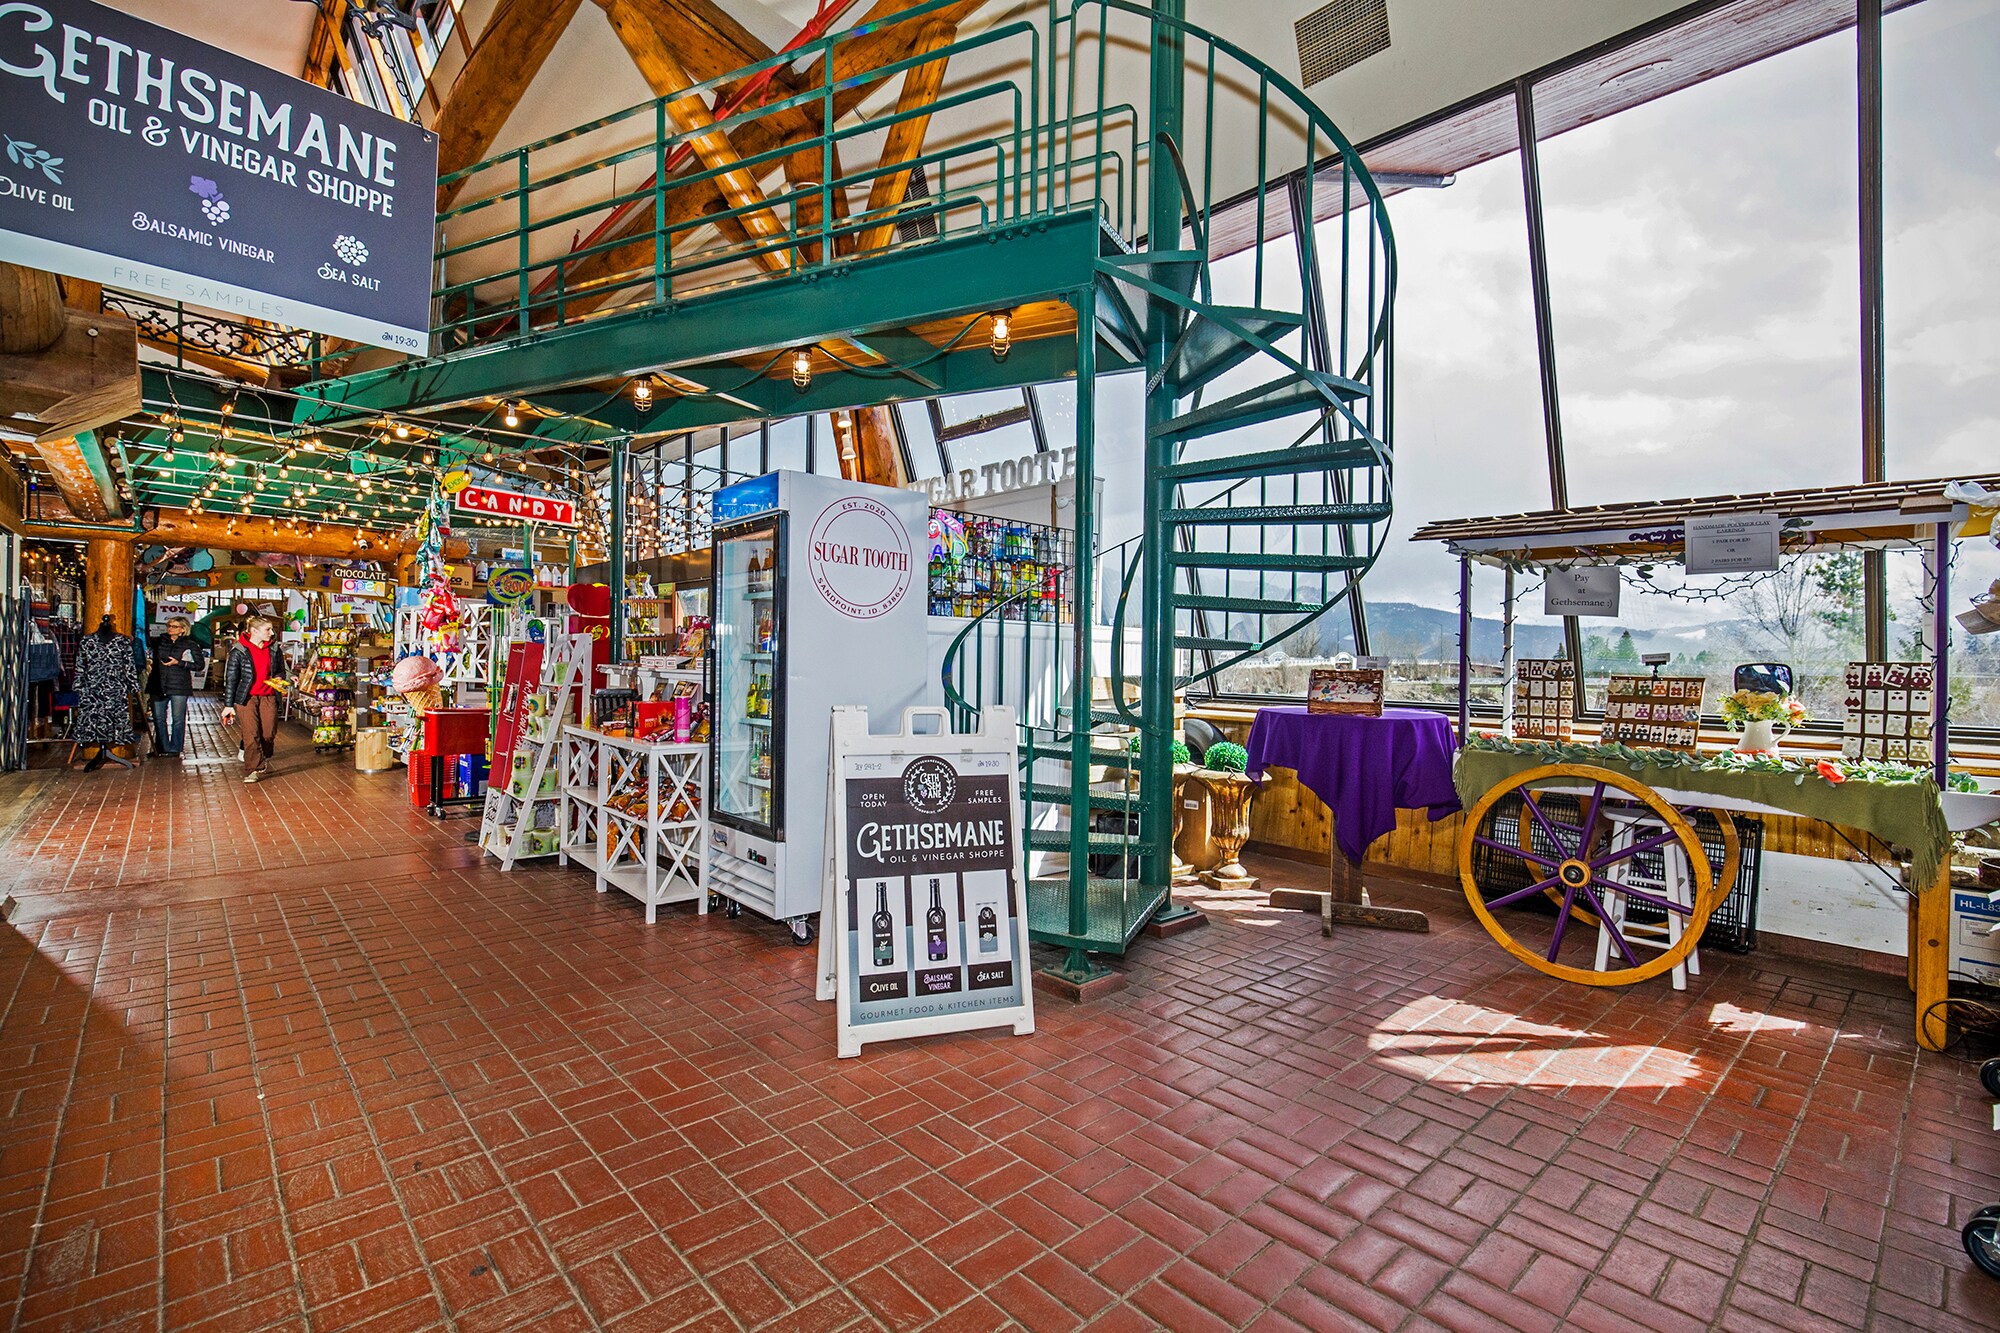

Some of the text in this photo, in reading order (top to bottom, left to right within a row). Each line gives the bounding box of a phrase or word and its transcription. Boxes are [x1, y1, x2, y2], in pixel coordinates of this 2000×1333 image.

[0, 3, 398, 188] GETHSEMANE
[88, 97, 393, 218] OIL & VINEGAR SHOPPE
[0, 175, 75, 212] OLIVE OIL
[132, 210, 275, 265] BALSAMIC VINEGAR
[317, 262, 381, 292] SEA SALT
[112, 265, 285, 319] FREE SAMPLES
[464, 490, 565, 520] CANDY
[842, 501, 886, 517] EST. 2020
[814, 540, 908, 572] SUGAR TOOTH
[334, 568, 388, 581] CHOCOLATE
[1573, 573, 1590, 584] Pay
[882, 586, 904, 610] 83864
[1577, 587, 1586, 595] at
[1550, 597, 1605, 608] Gethsemane
[968, 796, 1002, 804] SAMPLES
[975, 789, 993, 797] FREE
[860, 800, 887, 808] TODAY
[856, 820, 1005, 863] GETHSEMANE
[889, 849, 1005, 864] OIL & VINEGAR SHOPPE
[923, 973, 954, 984] BALSAMIC
[976, 971, 1004, 982] SEA SALT
[869, 982, 898, 993] OLIVE OIL
[928, 982, 951, 991] VINEGAR
[860, 996, 1015, 1020] GOURMET FOOD & KITCHEN ITEMS
